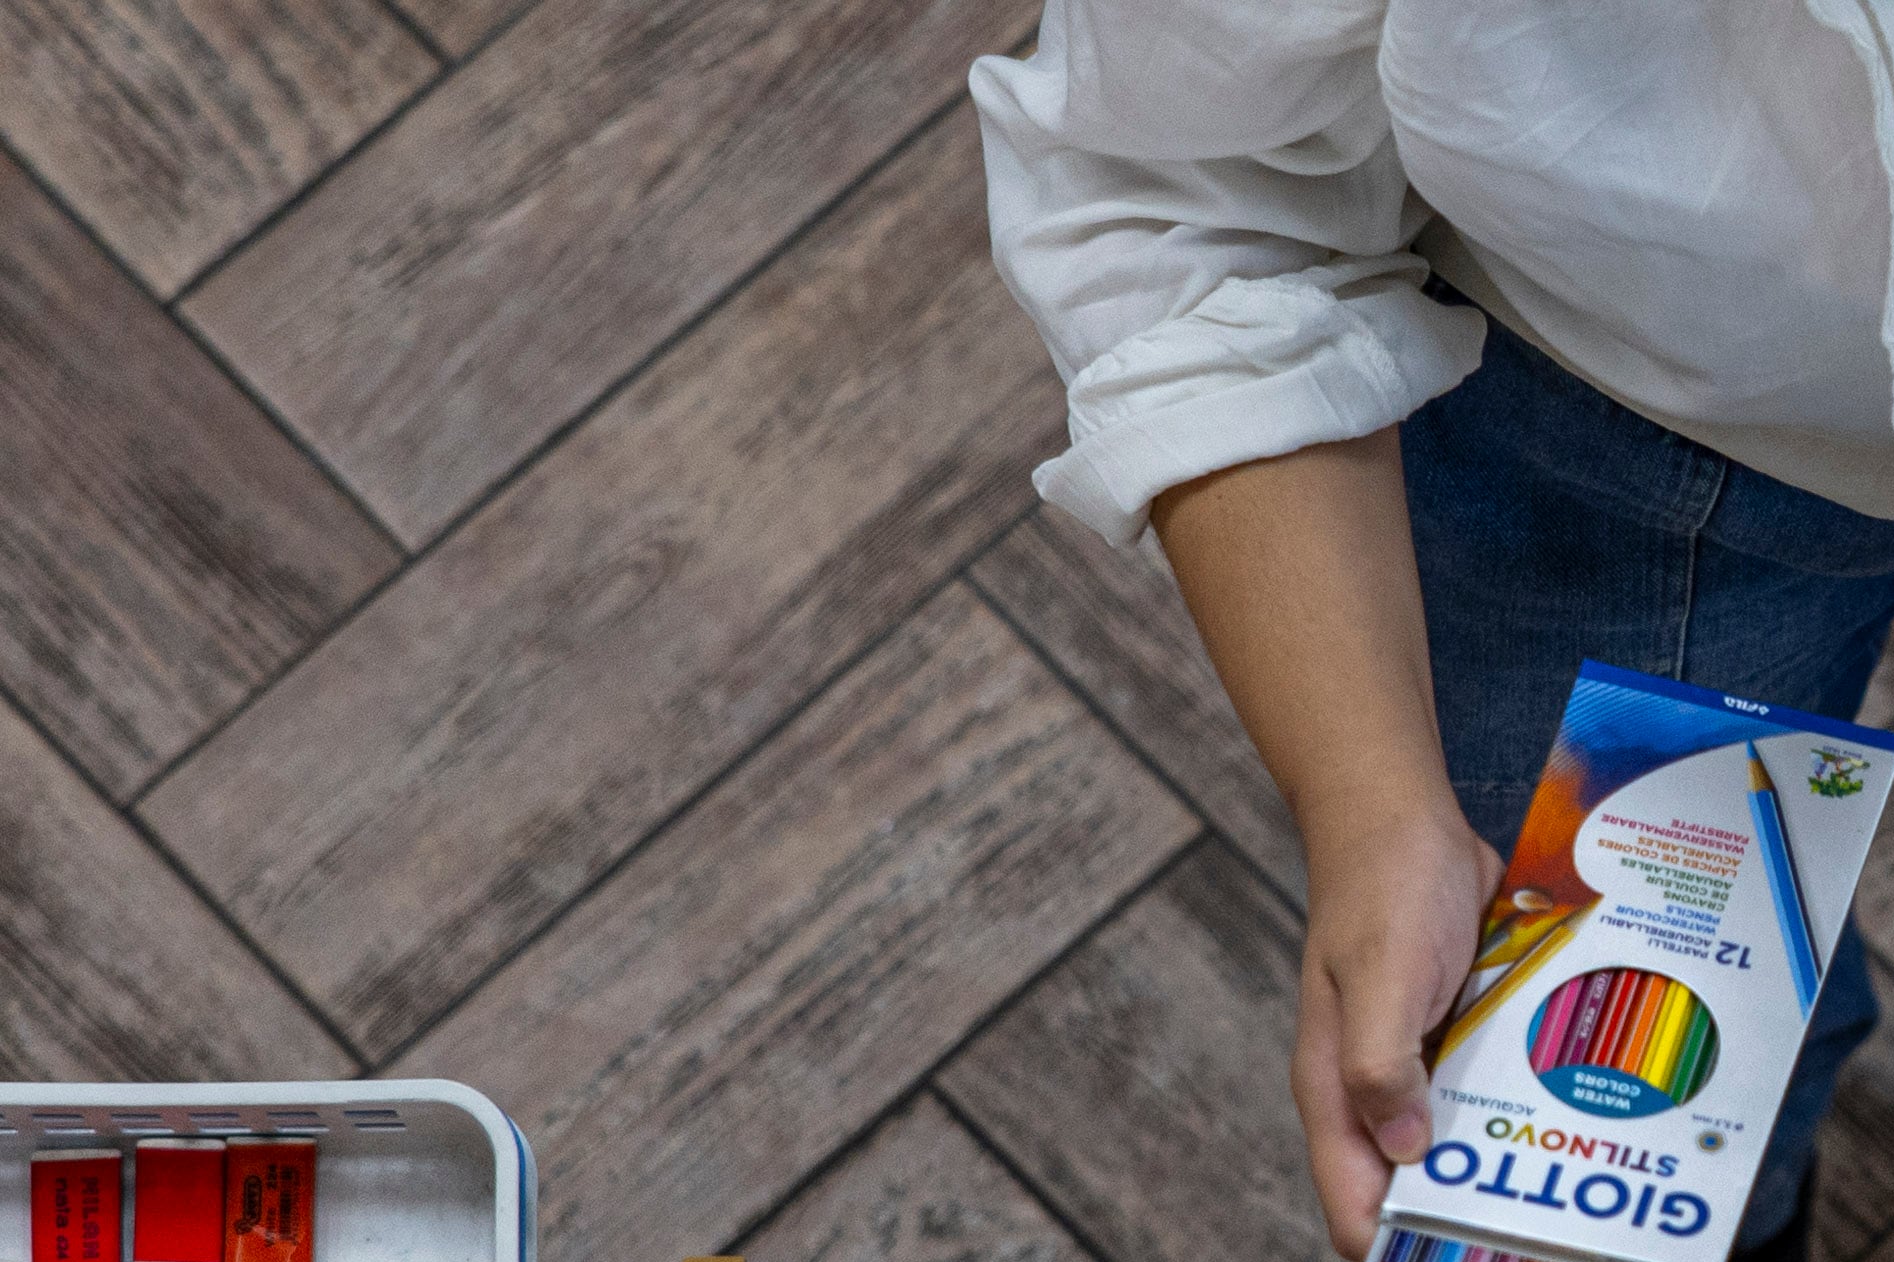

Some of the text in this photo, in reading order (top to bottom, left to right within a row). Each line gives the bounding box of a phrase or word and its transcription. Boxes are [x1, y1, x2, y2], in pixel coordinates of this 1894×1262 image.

[1600, 812, 1746, 855] WASSERVERMALBARE
[1597, 838, 1738, 879] LÁPICES DE COLORES
[1637, 836, 1742, 867] ACUARELABLES
[1619, 857, 1734, 890] AQUARELLABLES
[1646, 876, 1730, 902] DE COULEUR
[1662, 890, 1726, 912] CRAYONS
[1665, 904, 1721, 926] PENCILS
[1599, 914, 1713, 948] ACQUERELLABILI
[1615, 904, 1717, 935] WATERCOLOUR
[1647, 937, 1710, 960] PASTELLI
[1715, 939, 1753, 970] 12
[1572, 1085, 1632, 1111] WATER
[1573, 1070, 1641, 1099] COLORS
[1438, 1086, 1537, 1116] ACQUARELL
[1485, 1116, 1681, 1178] STILNOVO
[56, 1177, 70, 1229] nata
[1423, 1139, 1712, 1237] GIOTTO
[82, 1176, 99, 1260] MILAN
